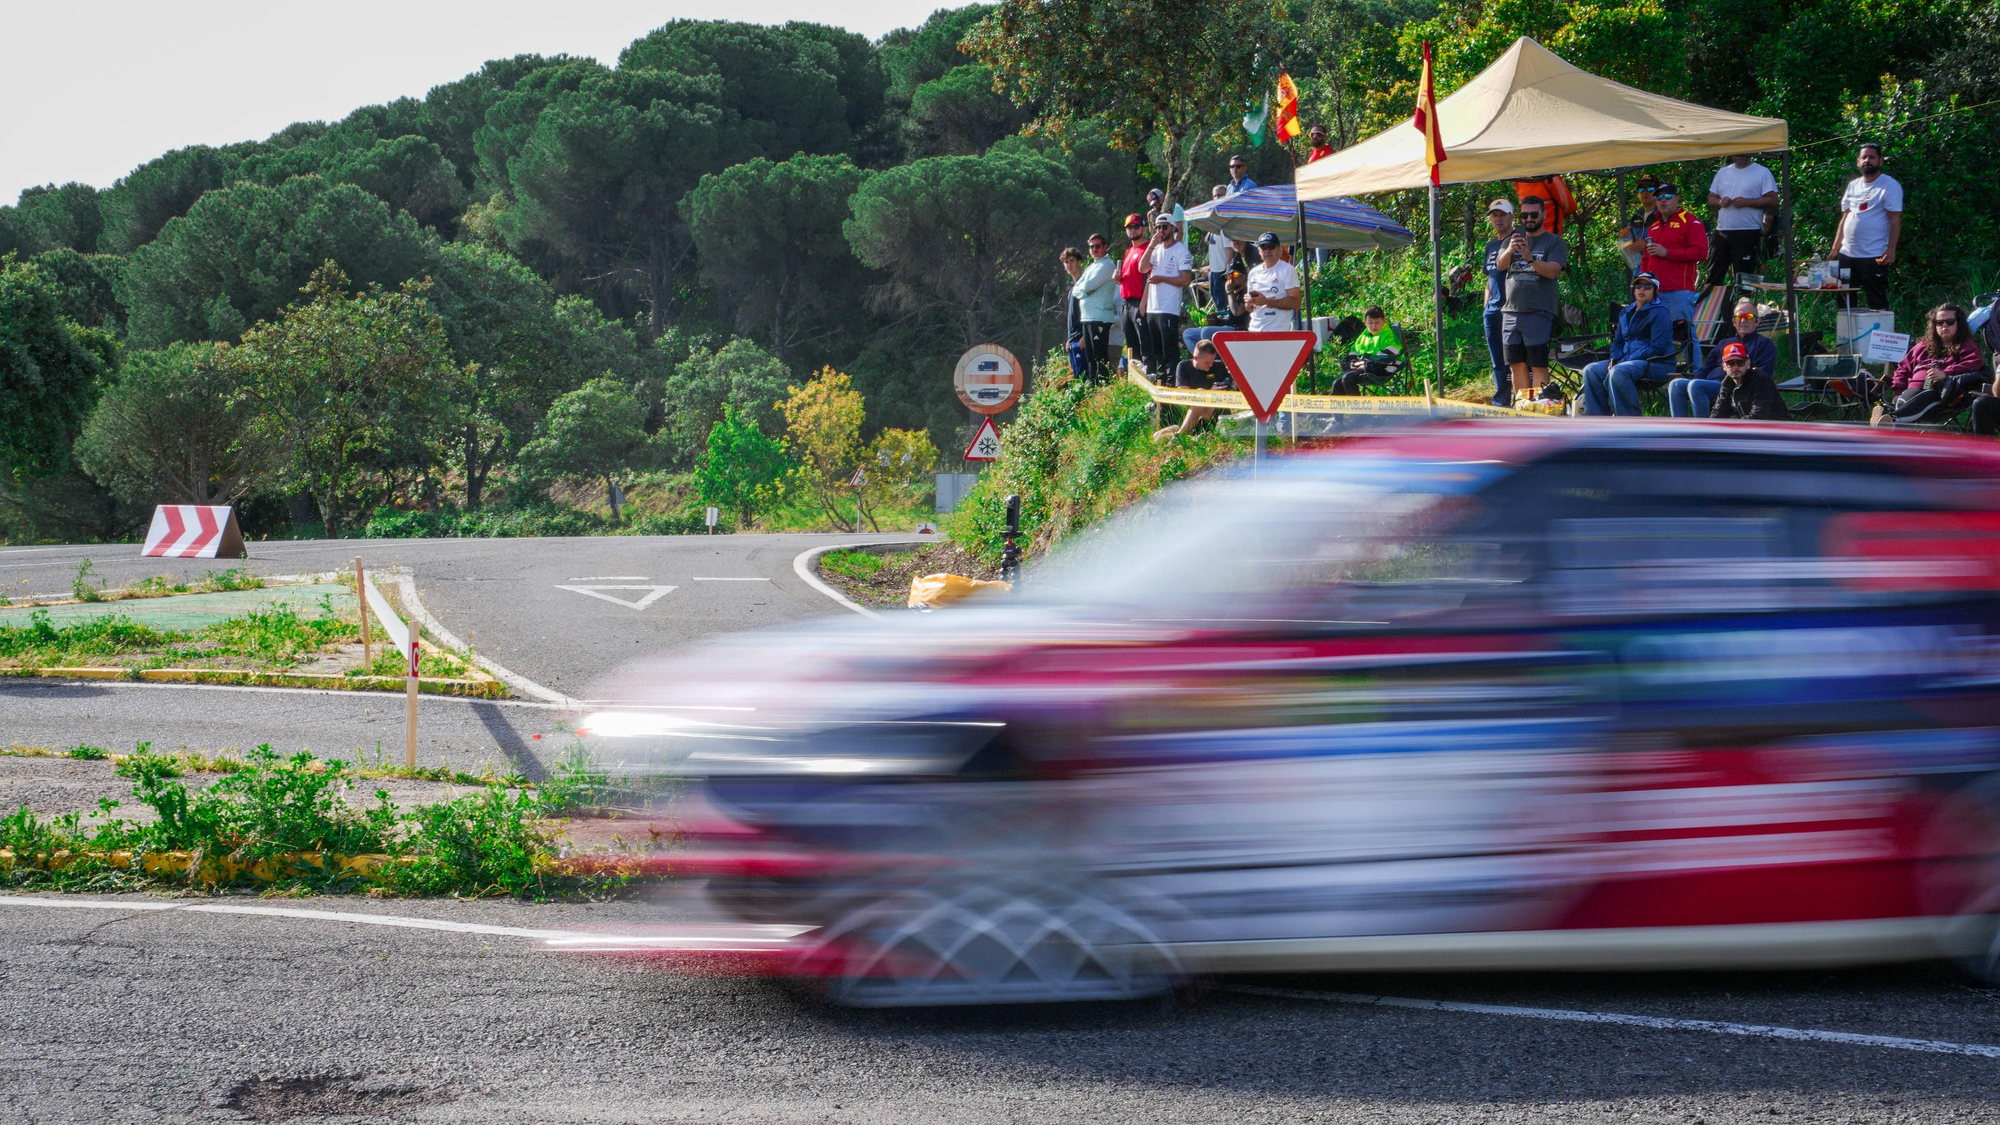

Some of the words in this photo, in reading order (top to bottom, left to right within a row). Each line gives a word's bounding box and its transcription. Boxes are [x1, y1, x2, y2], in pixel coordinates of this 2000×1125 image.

[1210, 393, 1222, 404] ZONA
[1330, 399, 1345, 410] ZONA
[1346, 399, 1372, 411] PUBLICO
[1378, 400, 1394, 410] ZONA
[1396, 400, 1422, 412] PUBLICO
